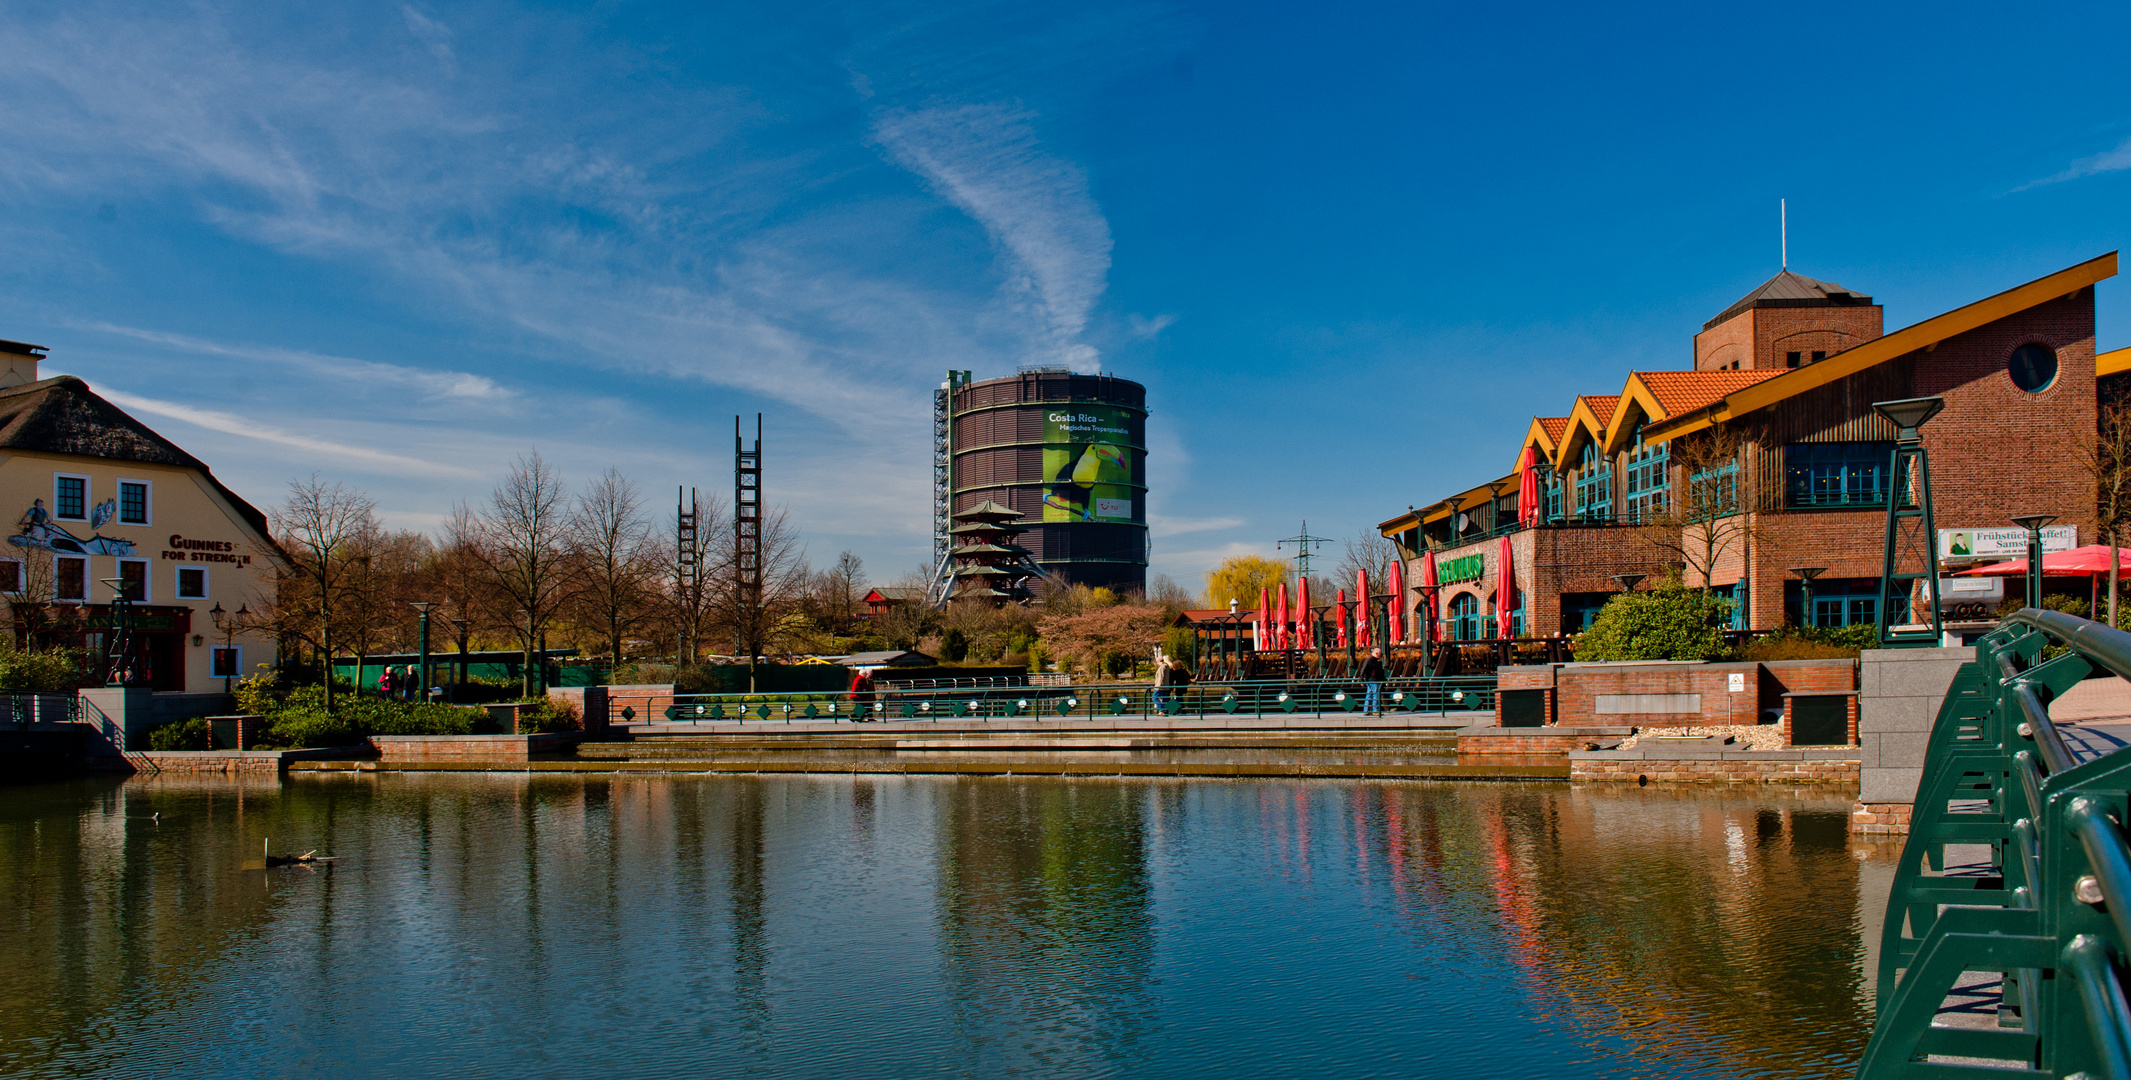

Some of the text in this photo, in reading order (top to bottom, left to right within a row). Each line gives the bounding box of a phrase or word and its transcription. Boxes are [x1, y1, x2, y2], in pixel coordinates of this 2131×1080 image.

[1049, 413, 1075, 422] Costa
[1079, 414, 1097, 422] Rica
[162, 551, 186, 560] FOR
